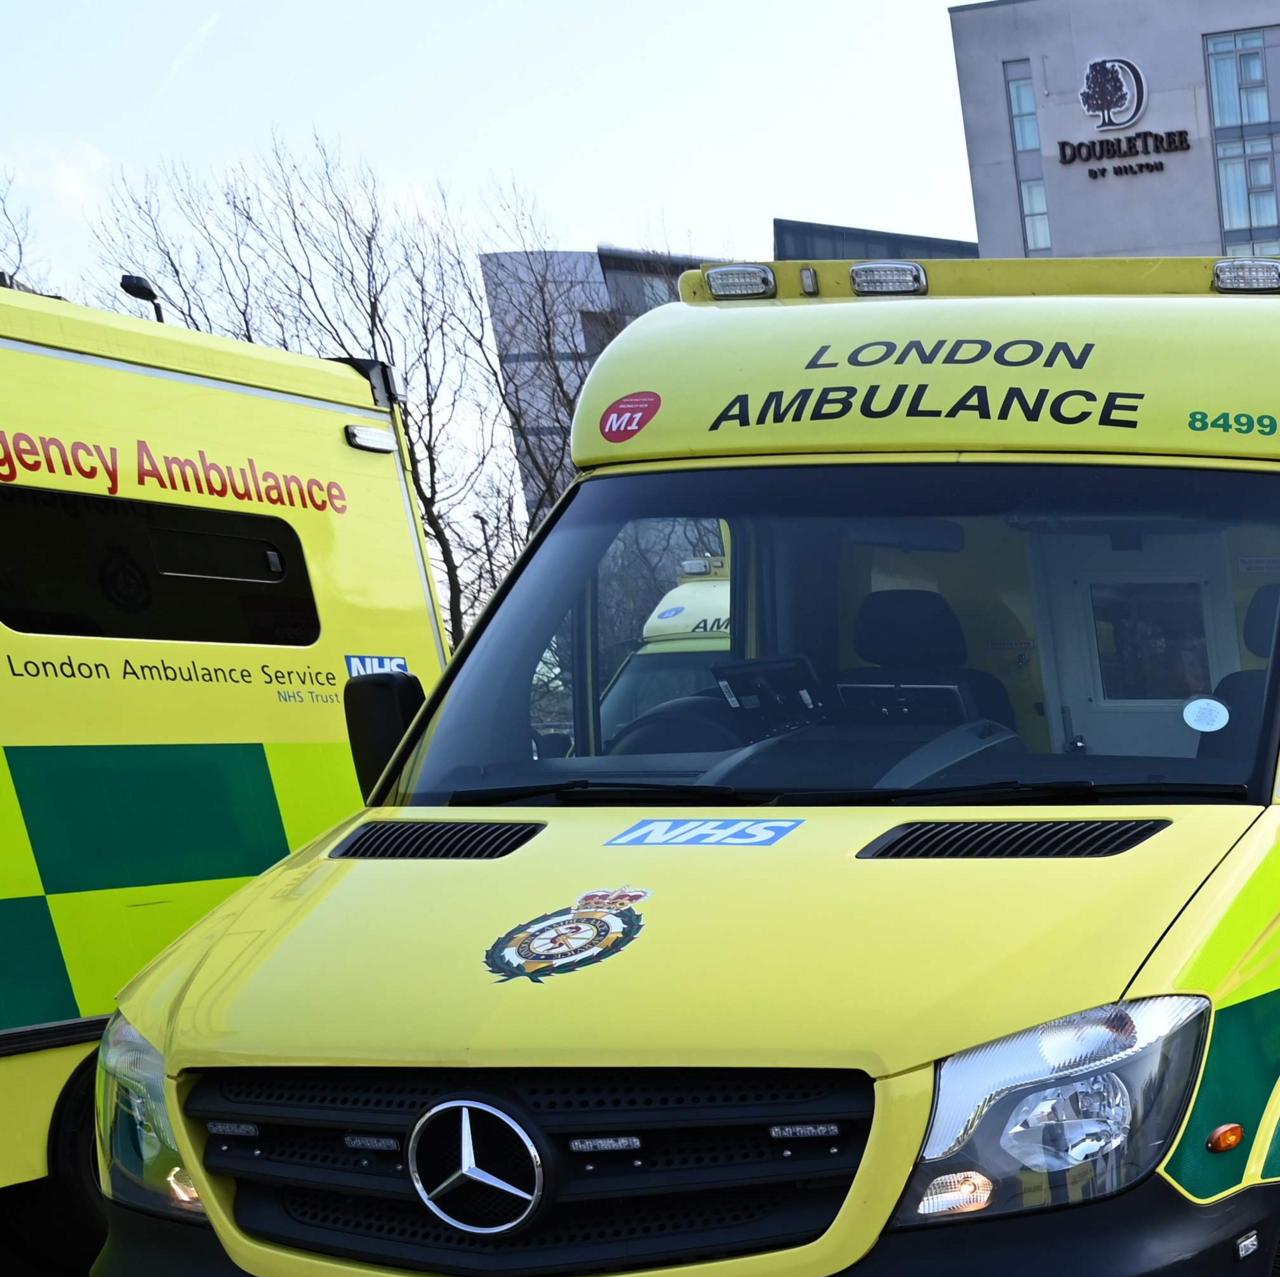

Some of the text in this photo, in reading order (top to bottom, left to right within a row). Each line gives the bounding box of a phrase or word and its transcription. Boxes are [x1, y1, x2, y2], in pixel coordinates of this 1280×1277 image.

[1088, 161, 1165, 180] BY HILTON
[804, 339, 1095, 369] LONDON
[708, 384, 1145, 431] AMBULANCE
[605, 412, 643, 432] M1
[1187, 411, 1278, 436] 8499
[136, 440, 348, 514] Ambulance
[7, 654, 337, 687] London Ambulance Service
[277, 690, 341, 704] NHS Trust
[612, 820, 795, 844] NHS
